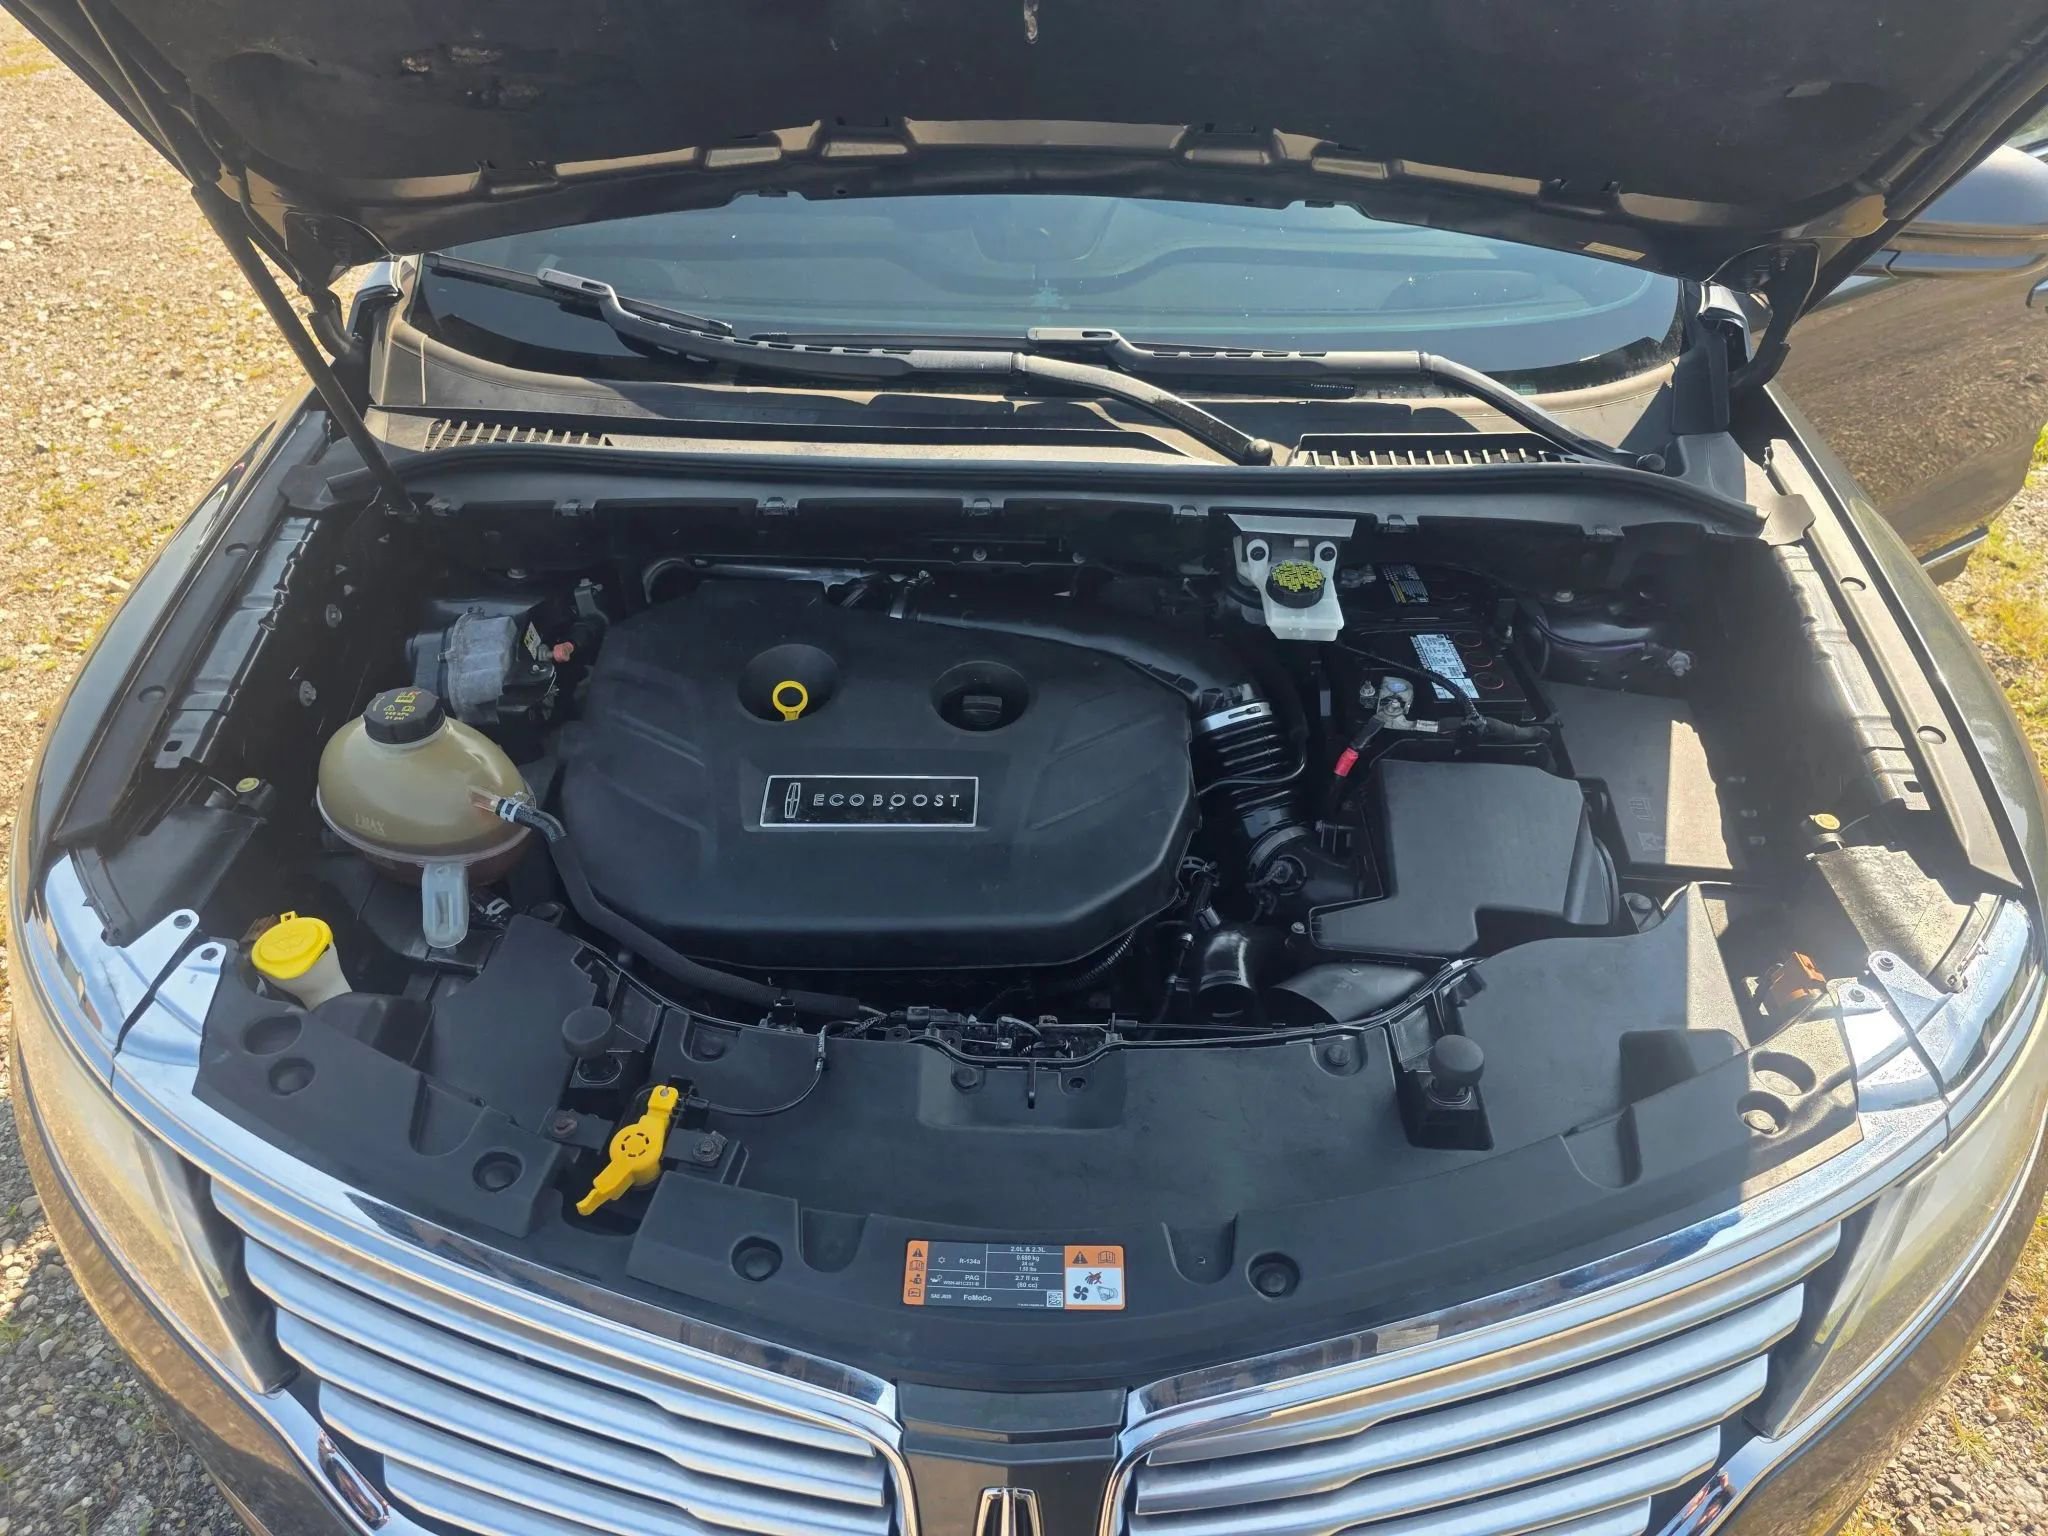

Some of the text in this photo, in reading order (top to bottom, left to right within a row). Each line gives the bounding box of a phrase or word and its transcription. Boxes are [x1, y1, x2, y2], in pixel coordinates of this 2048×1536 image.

[813, 793, 960, 807] ECOBOOST
[959, 1257, 981, 1265] R-134a
[963, 1293, 993, 1302] FoMoCo
